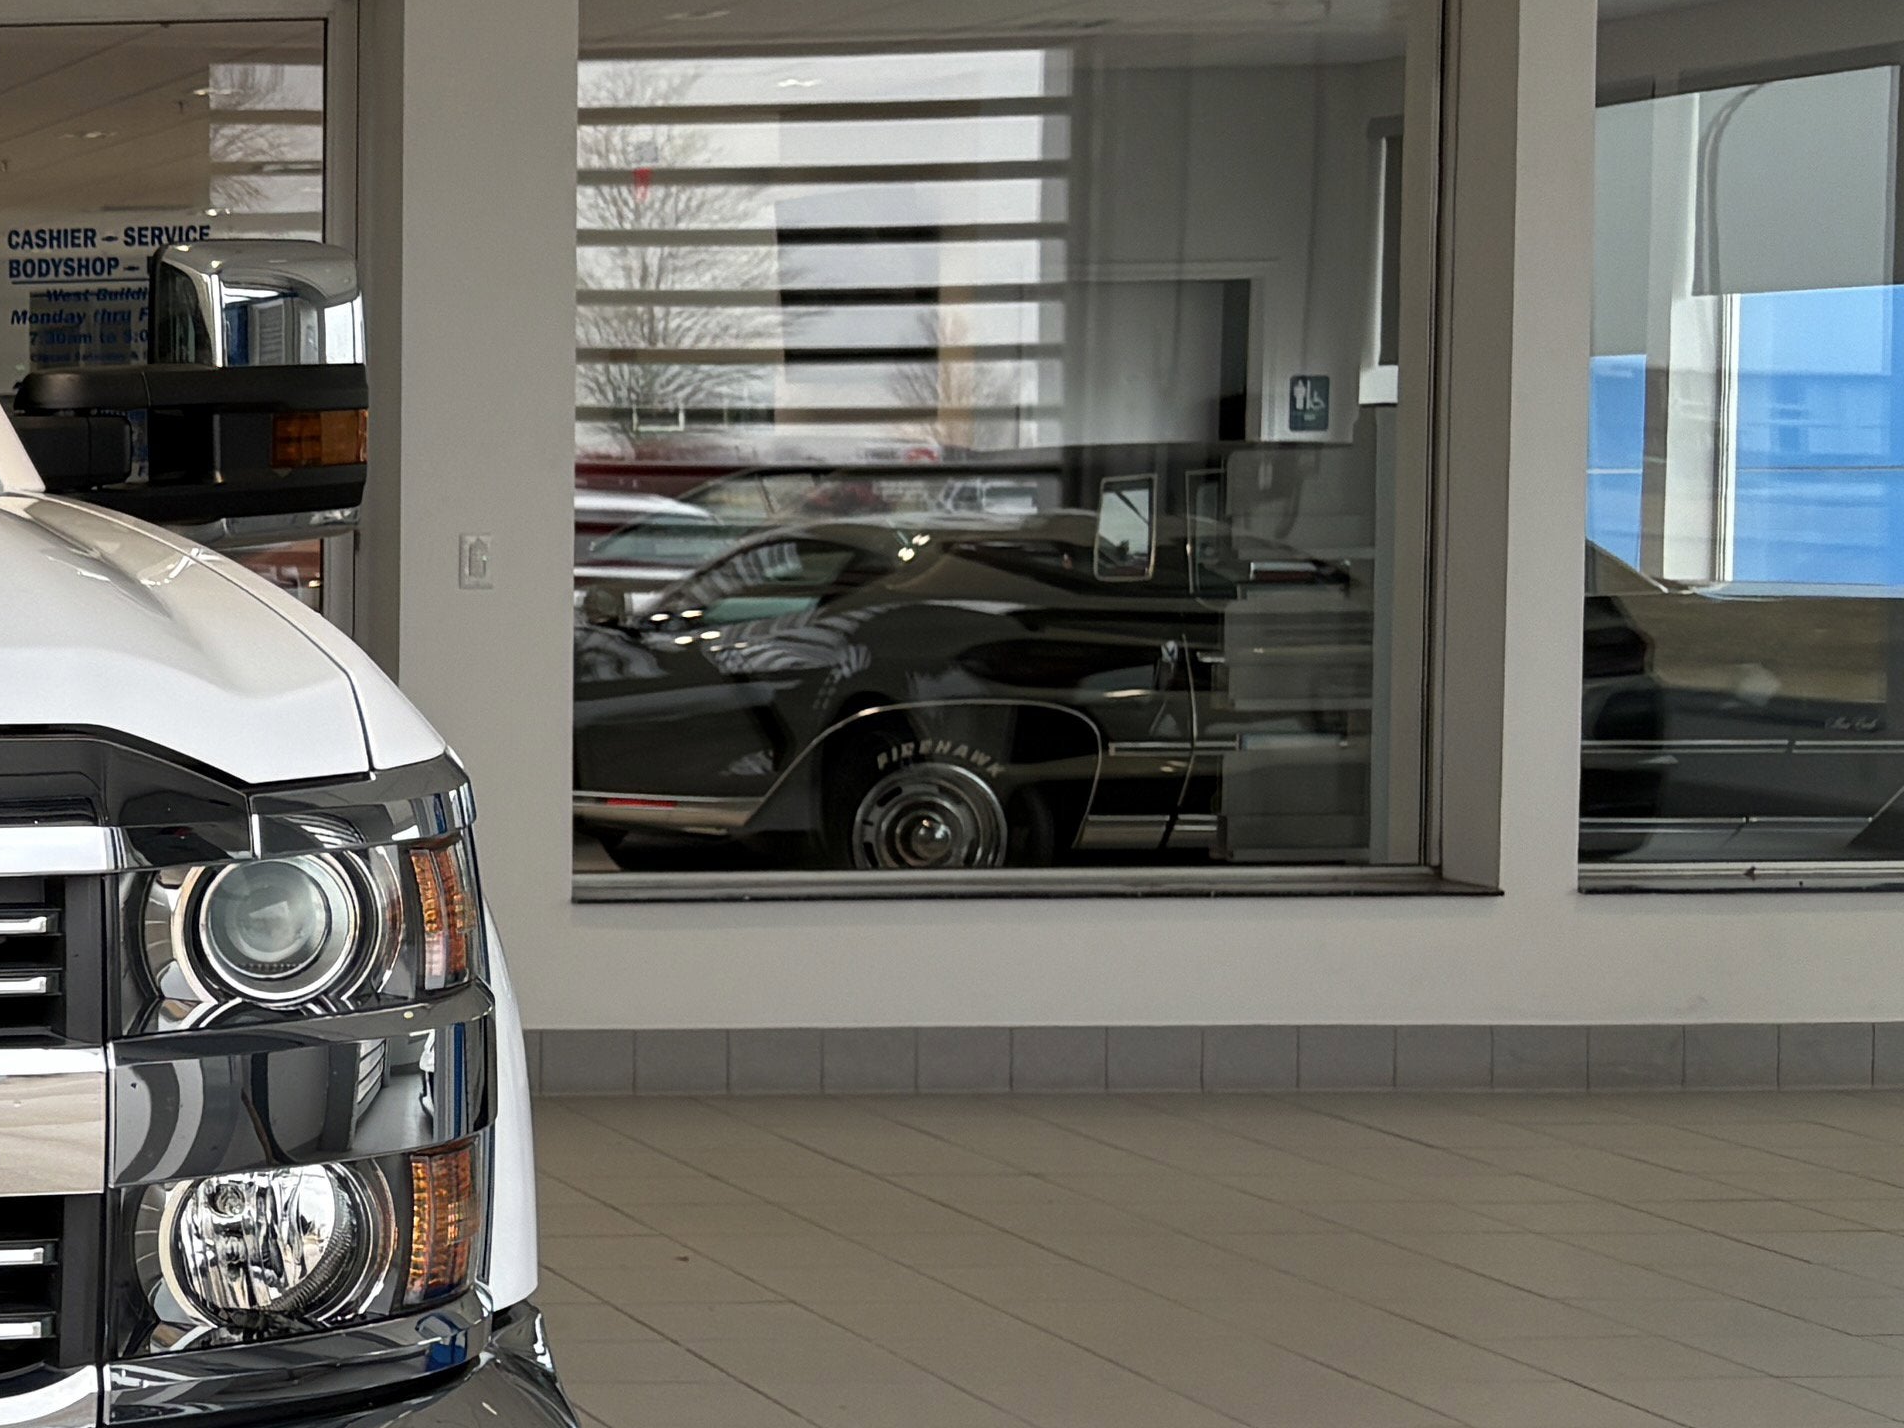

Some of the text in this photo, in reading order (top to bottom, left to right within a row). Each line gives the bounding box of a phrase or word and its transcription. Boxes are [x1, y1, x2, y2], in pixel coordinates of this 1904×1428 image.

[7, 225, 211, 250] CASHIER SERVICE
[8, 256, 120, 279] BODYSHOP
[46, 287, 148, 302] West Buildi
[11, 309, 86, 326] Monday
[94, 308, 132, 322] thru
[877, 738, 1006, 777] FIREHAWK
